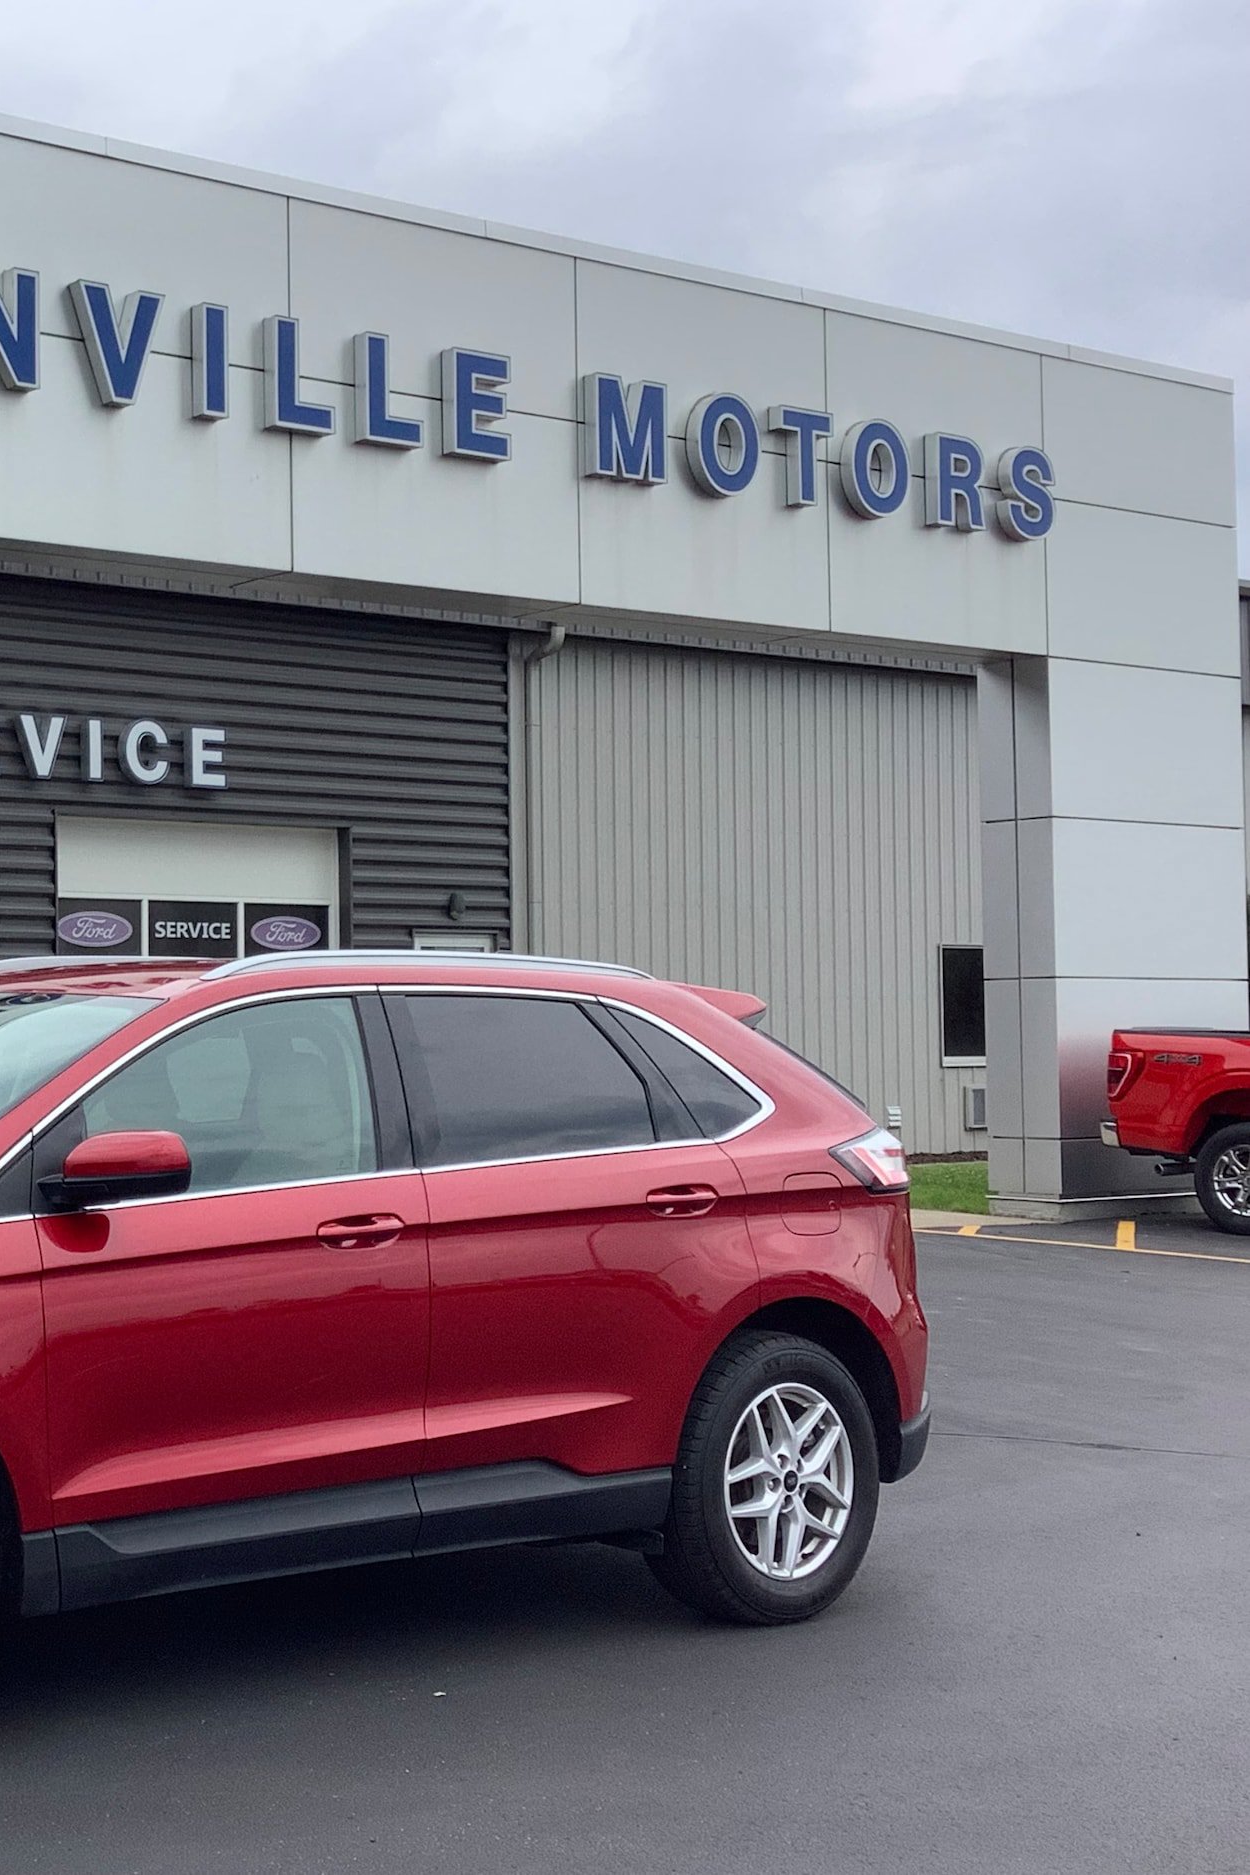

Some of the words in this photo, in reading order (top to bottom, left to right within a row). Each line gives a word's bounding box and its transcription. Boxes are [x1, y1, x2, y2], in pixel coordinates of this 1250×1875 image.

[582, 371, 1057, 541] MOTORS
[71, 917, 118, 941] Ford
[154, 920, 232, 940] SERVICE
[264, 921, 307, 944] Ford
